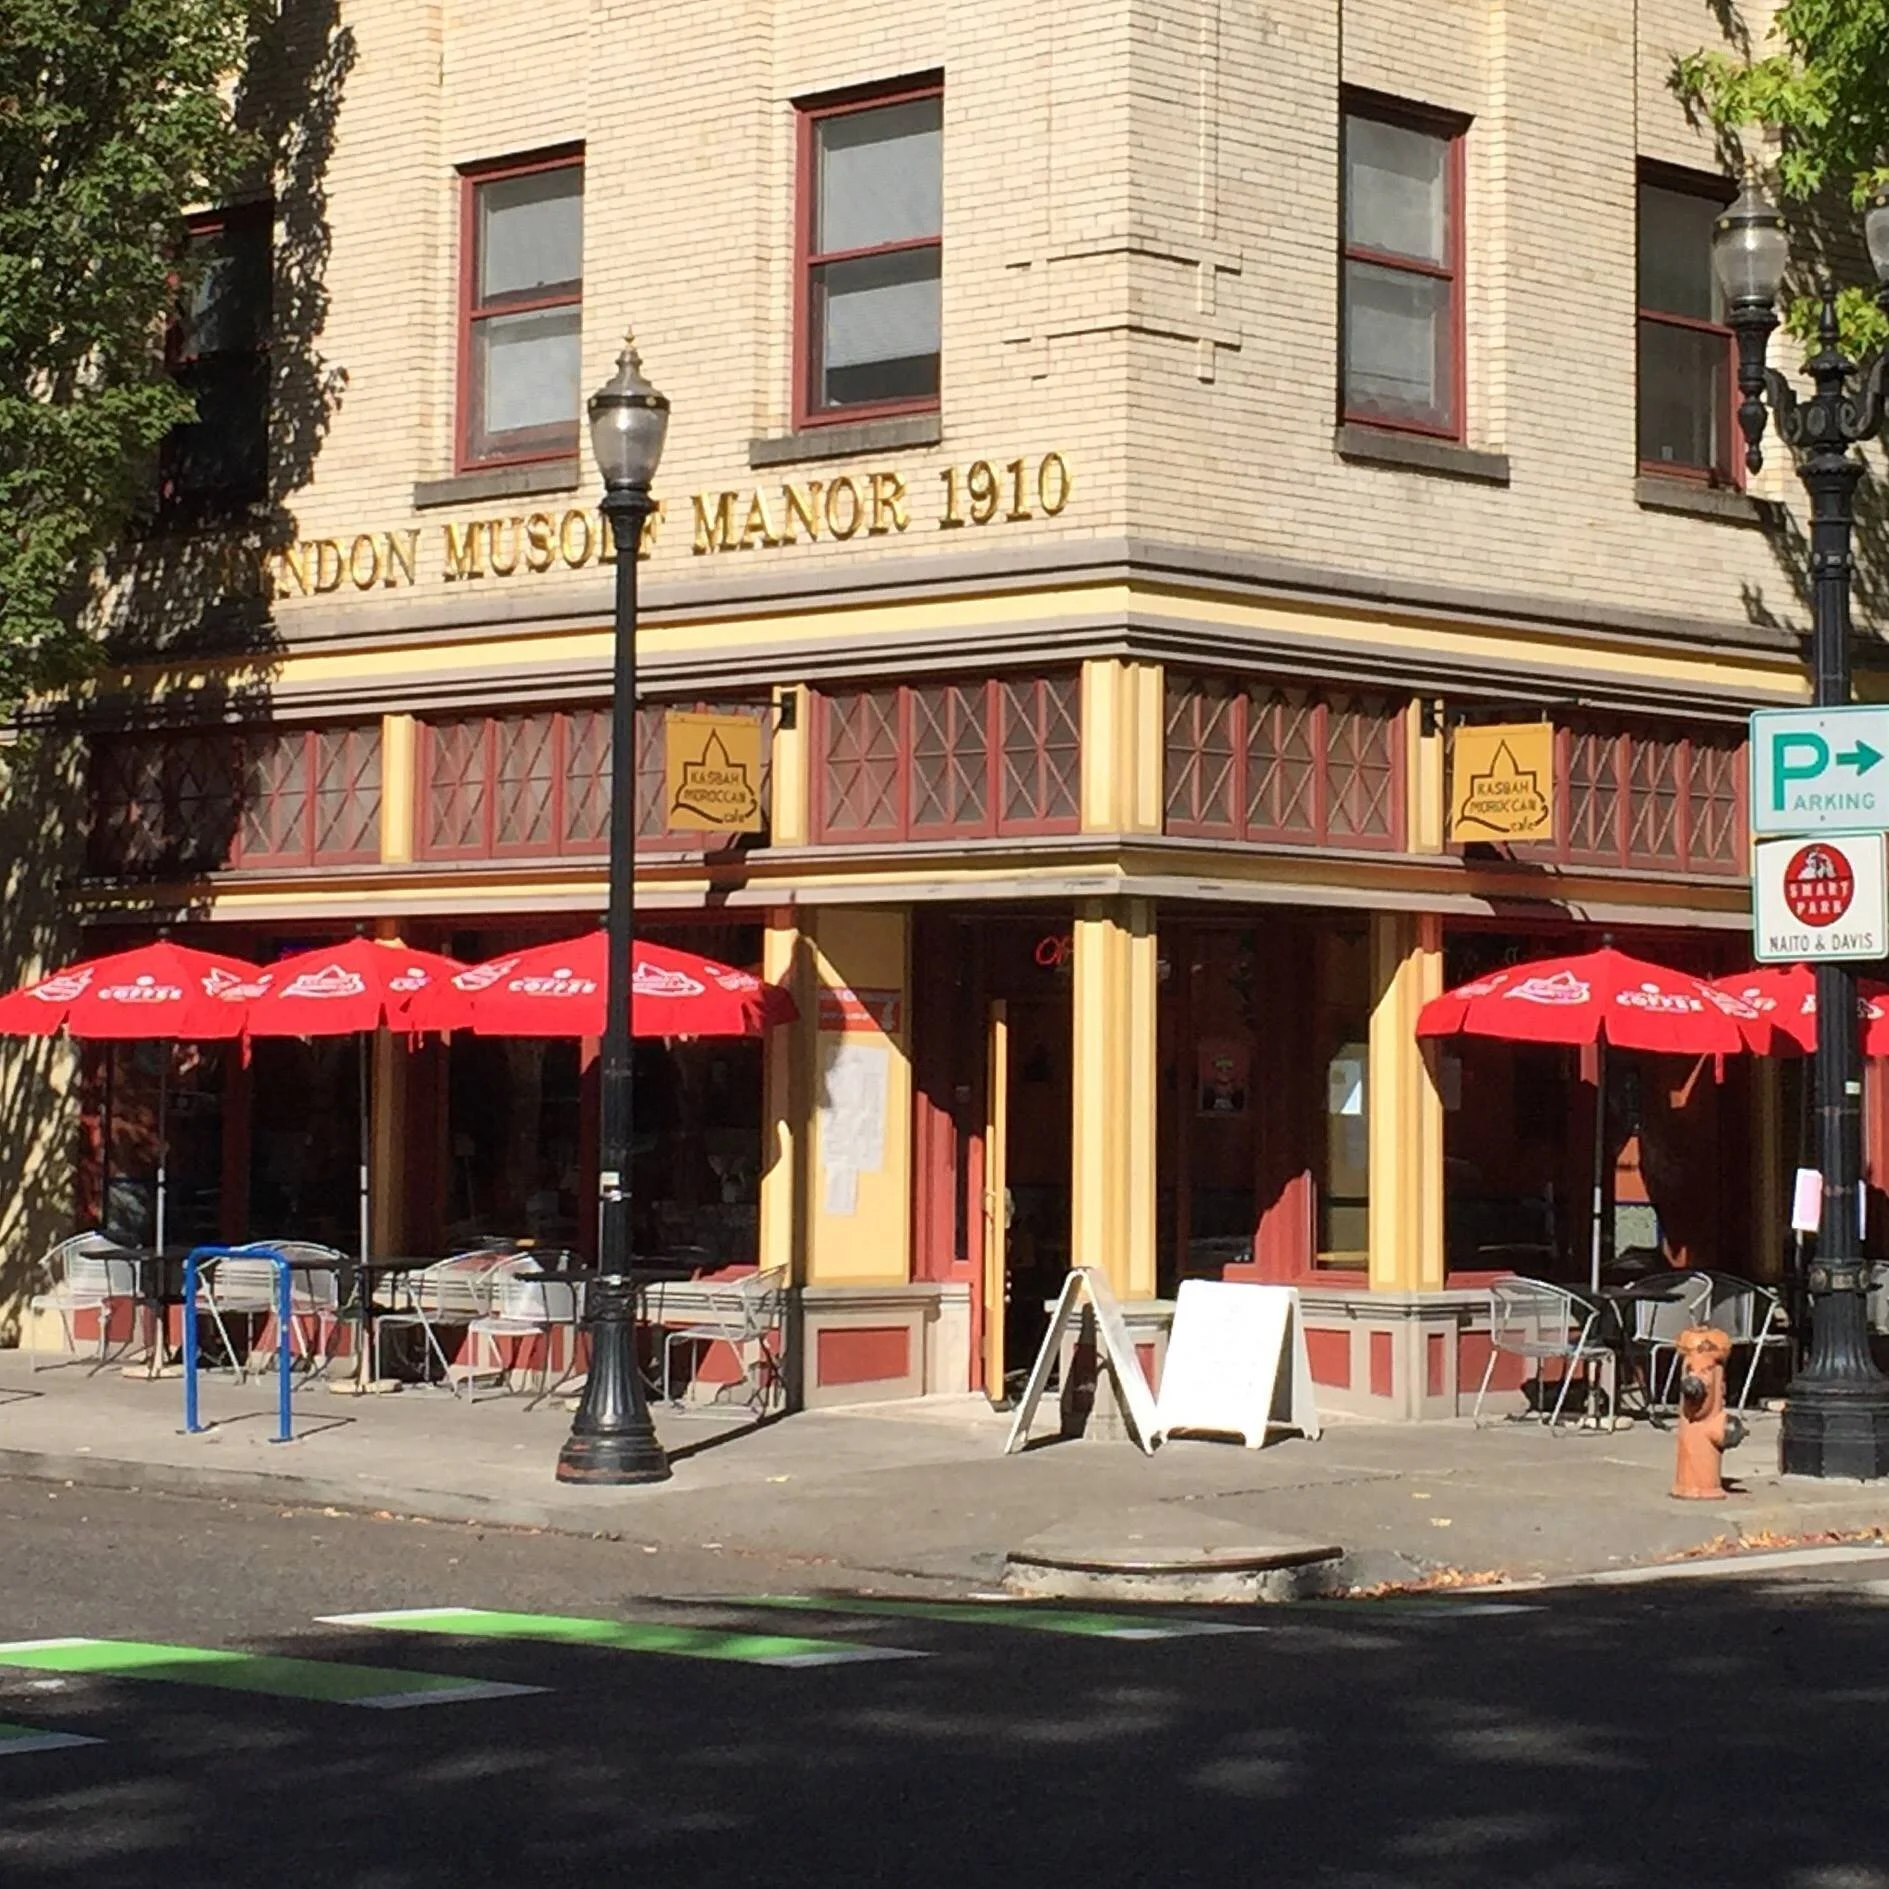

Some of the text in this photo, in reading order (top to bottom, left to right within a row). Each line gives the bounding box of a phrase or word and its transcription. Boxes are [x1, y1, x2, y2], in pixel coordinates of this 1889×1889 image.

[690, 472, 911, 556] MANOR
[938, 451, 1072, 529] 1910
[1477, 781, 1530, 796] KASBAH
[1789, 881, 1849, 899] SMART
[1797, 900, 1843, 916] PARK
[1769, 932, 1873, 953] NAITO & DAVIS
